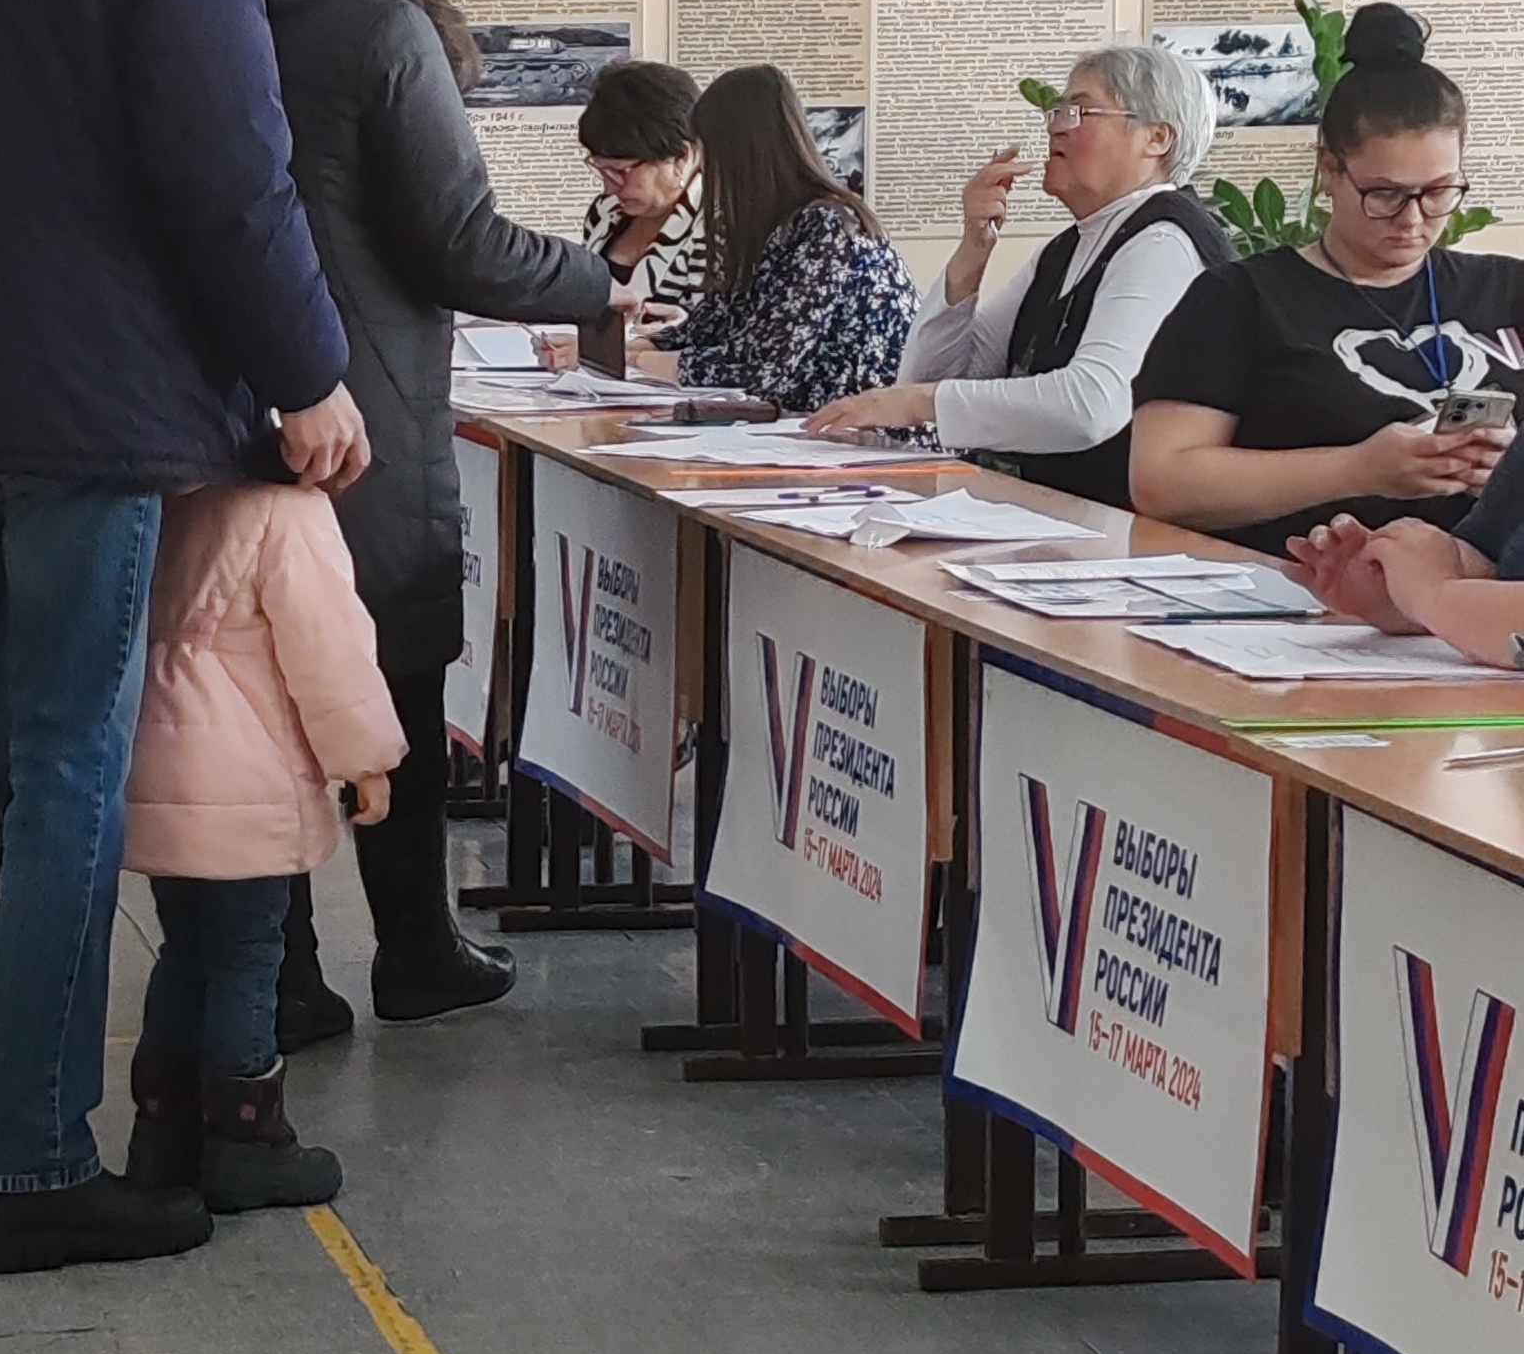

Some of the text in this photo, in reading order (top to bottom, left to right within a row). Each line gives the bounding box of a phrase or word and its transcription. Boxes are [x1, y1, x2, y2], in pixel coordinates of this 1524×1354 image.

[820, 665, 878, 729] ВЫБОРЫ
[755, 630, 816, 850] V
[813, 720, 896, 799] ПРЕЗИДЕНТА
[807, 775, 860, 837] РОССИИ
[827, 843, 859, 891] МАРТА
[858, 861, 883, 903] 2024
[1113, 819, 1198, 899] ВЫБОРЫ
[1018, 773, 1107, 1037] V
[1102, 884, 1222, 986] ПРЕЗИДЕНТА
[1094, 948, 1170, 1028] РОССИИ
[1123, 1029, 1168, 1093] МАРТА
[1168, 1055, 1202, 1111] 2024
[1393, 944, 1516, 1278] V
[1488, 1249, 1524, 1313] 15-1
